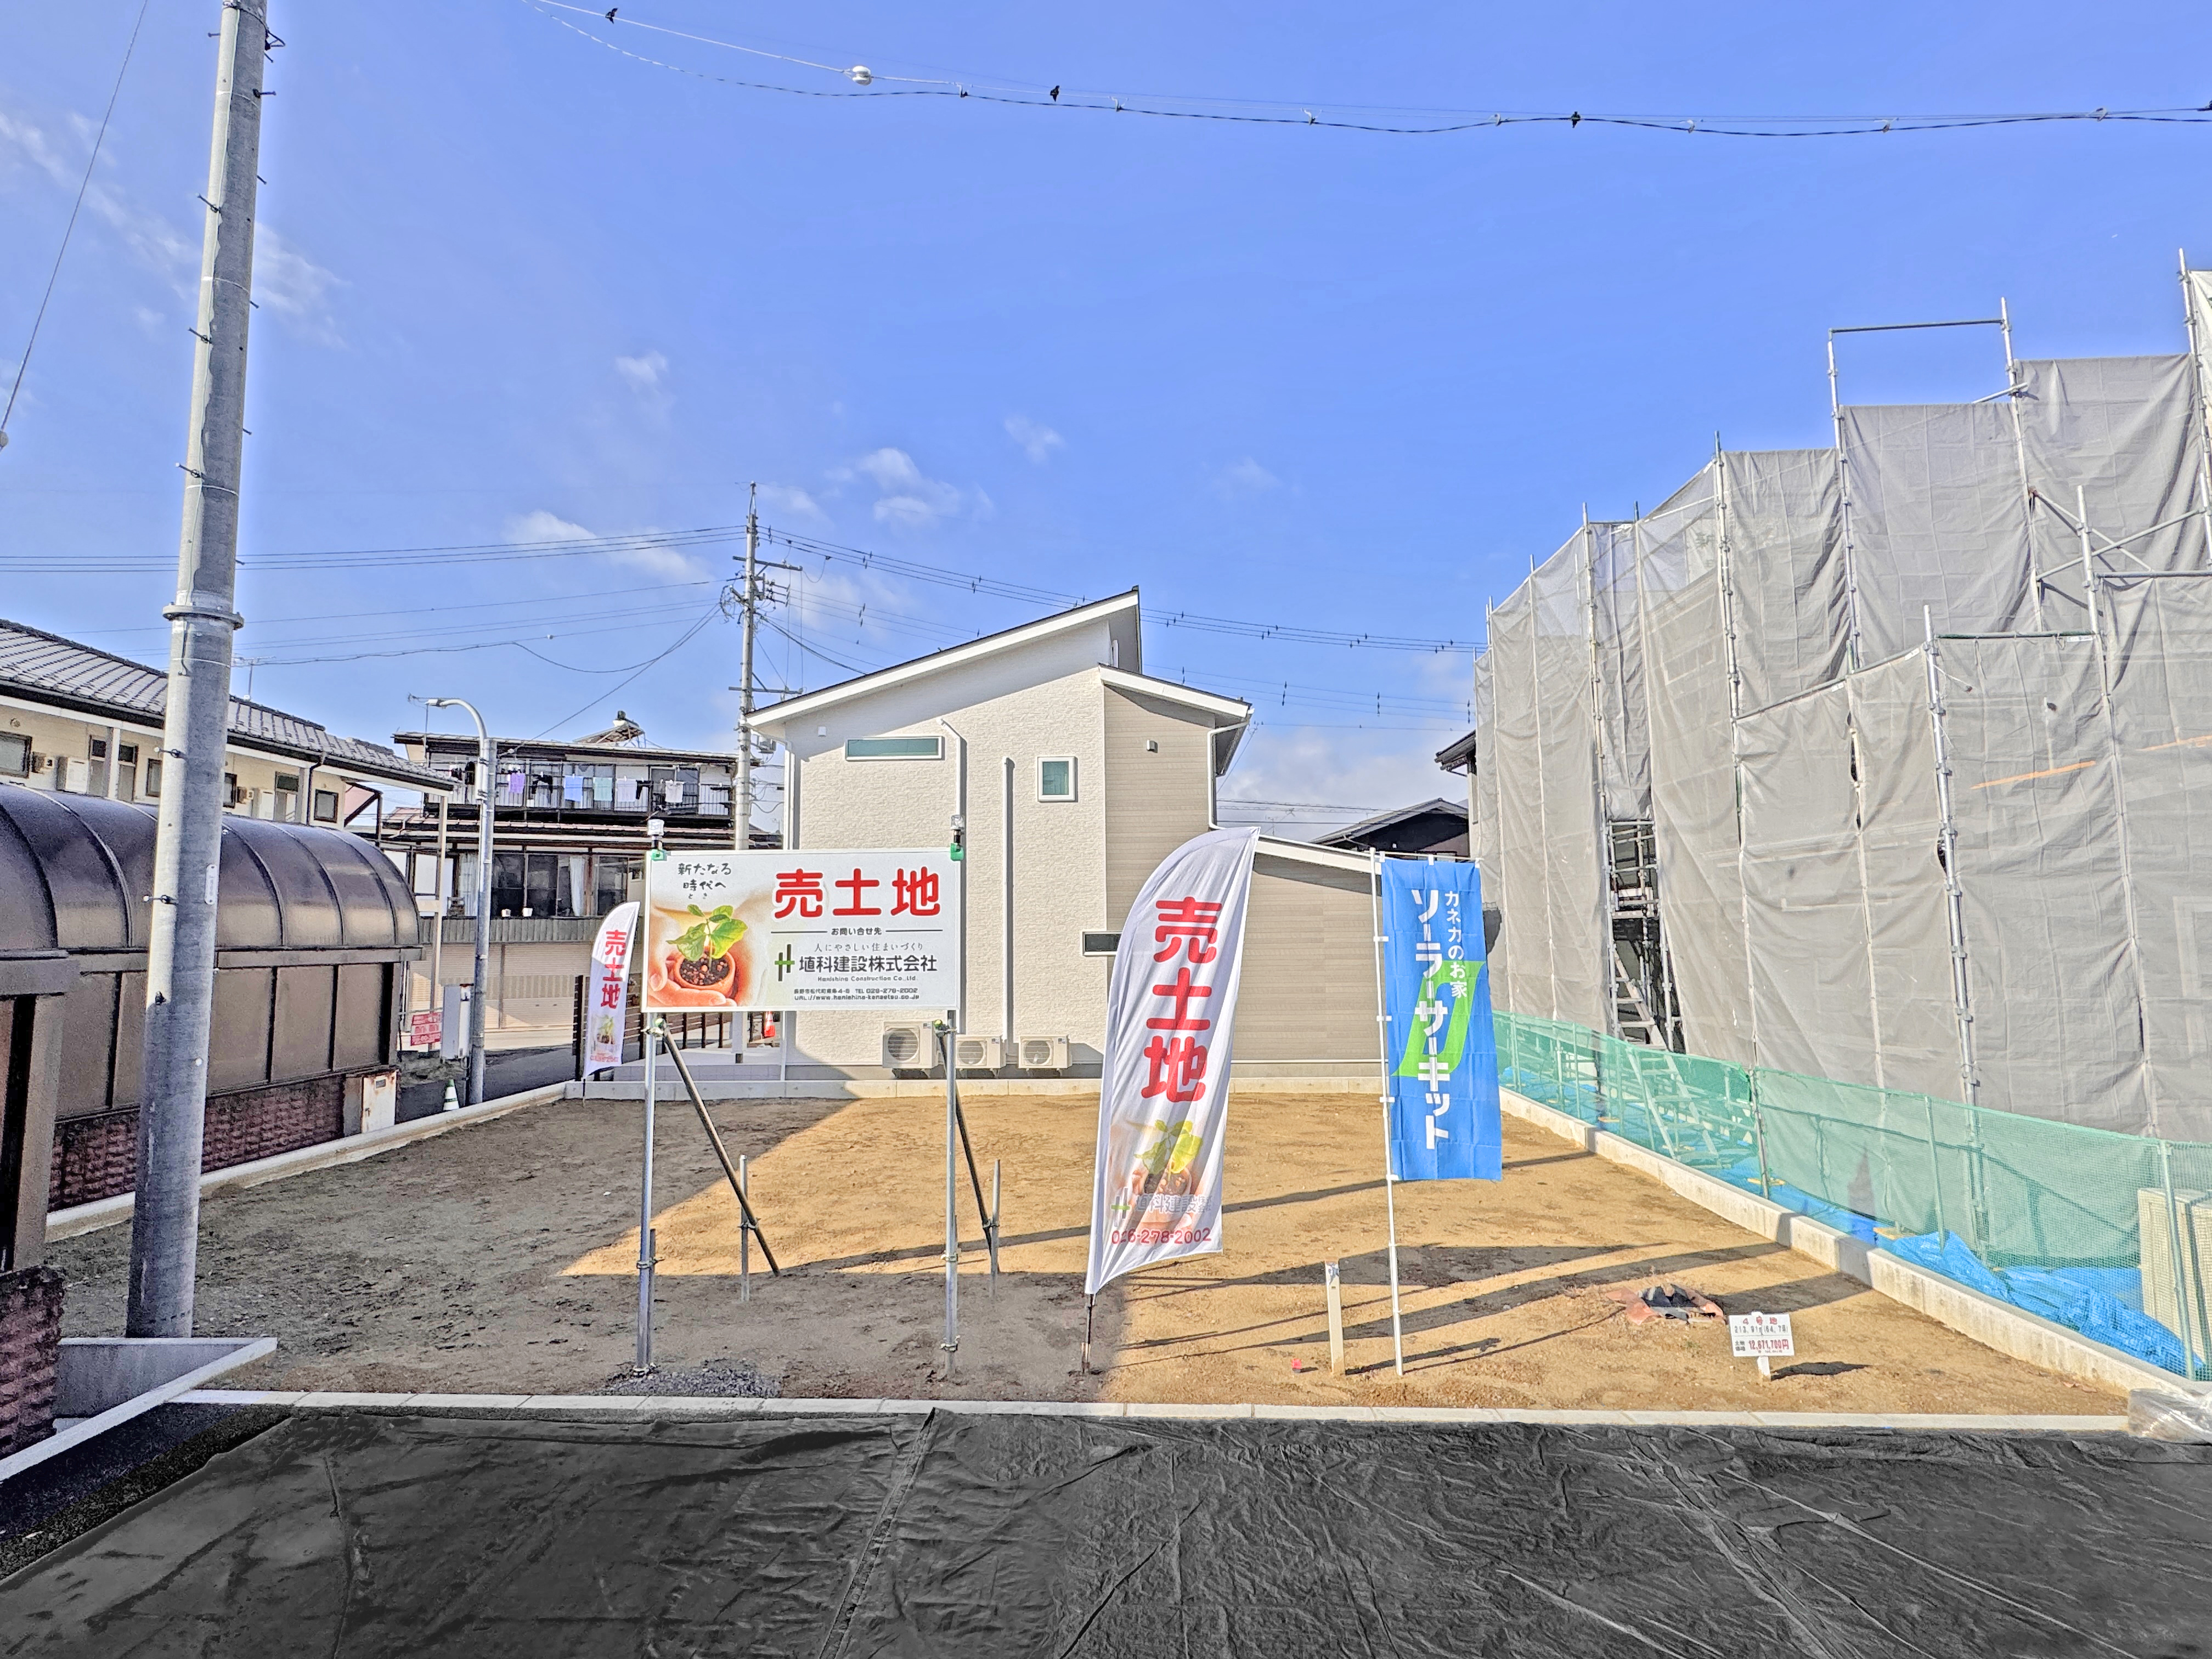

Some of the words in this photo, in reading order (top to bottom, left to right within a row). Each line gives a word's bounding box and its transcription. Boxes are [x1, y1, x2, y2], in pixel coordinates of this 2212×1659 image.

[678, 863, 731, 876] 新たなる
[683, 879, 726, 891] 時代へ
[774, 866, 941, 919] 売土地
[814, 943, 923, 952] 人にやさしい住まいづくり
[831, 927, 882, 936] お問い合せ先
[1444, 890, 1468, 998] カネカのお家
[600, 929, 627, 1009] 売土地
[799, 955, 938, 973] 埴科建設株式会社
[1141, 896, 1222, 1103] 売土地
[1411, 889, 1450, 1149] ソーラーサーキット
